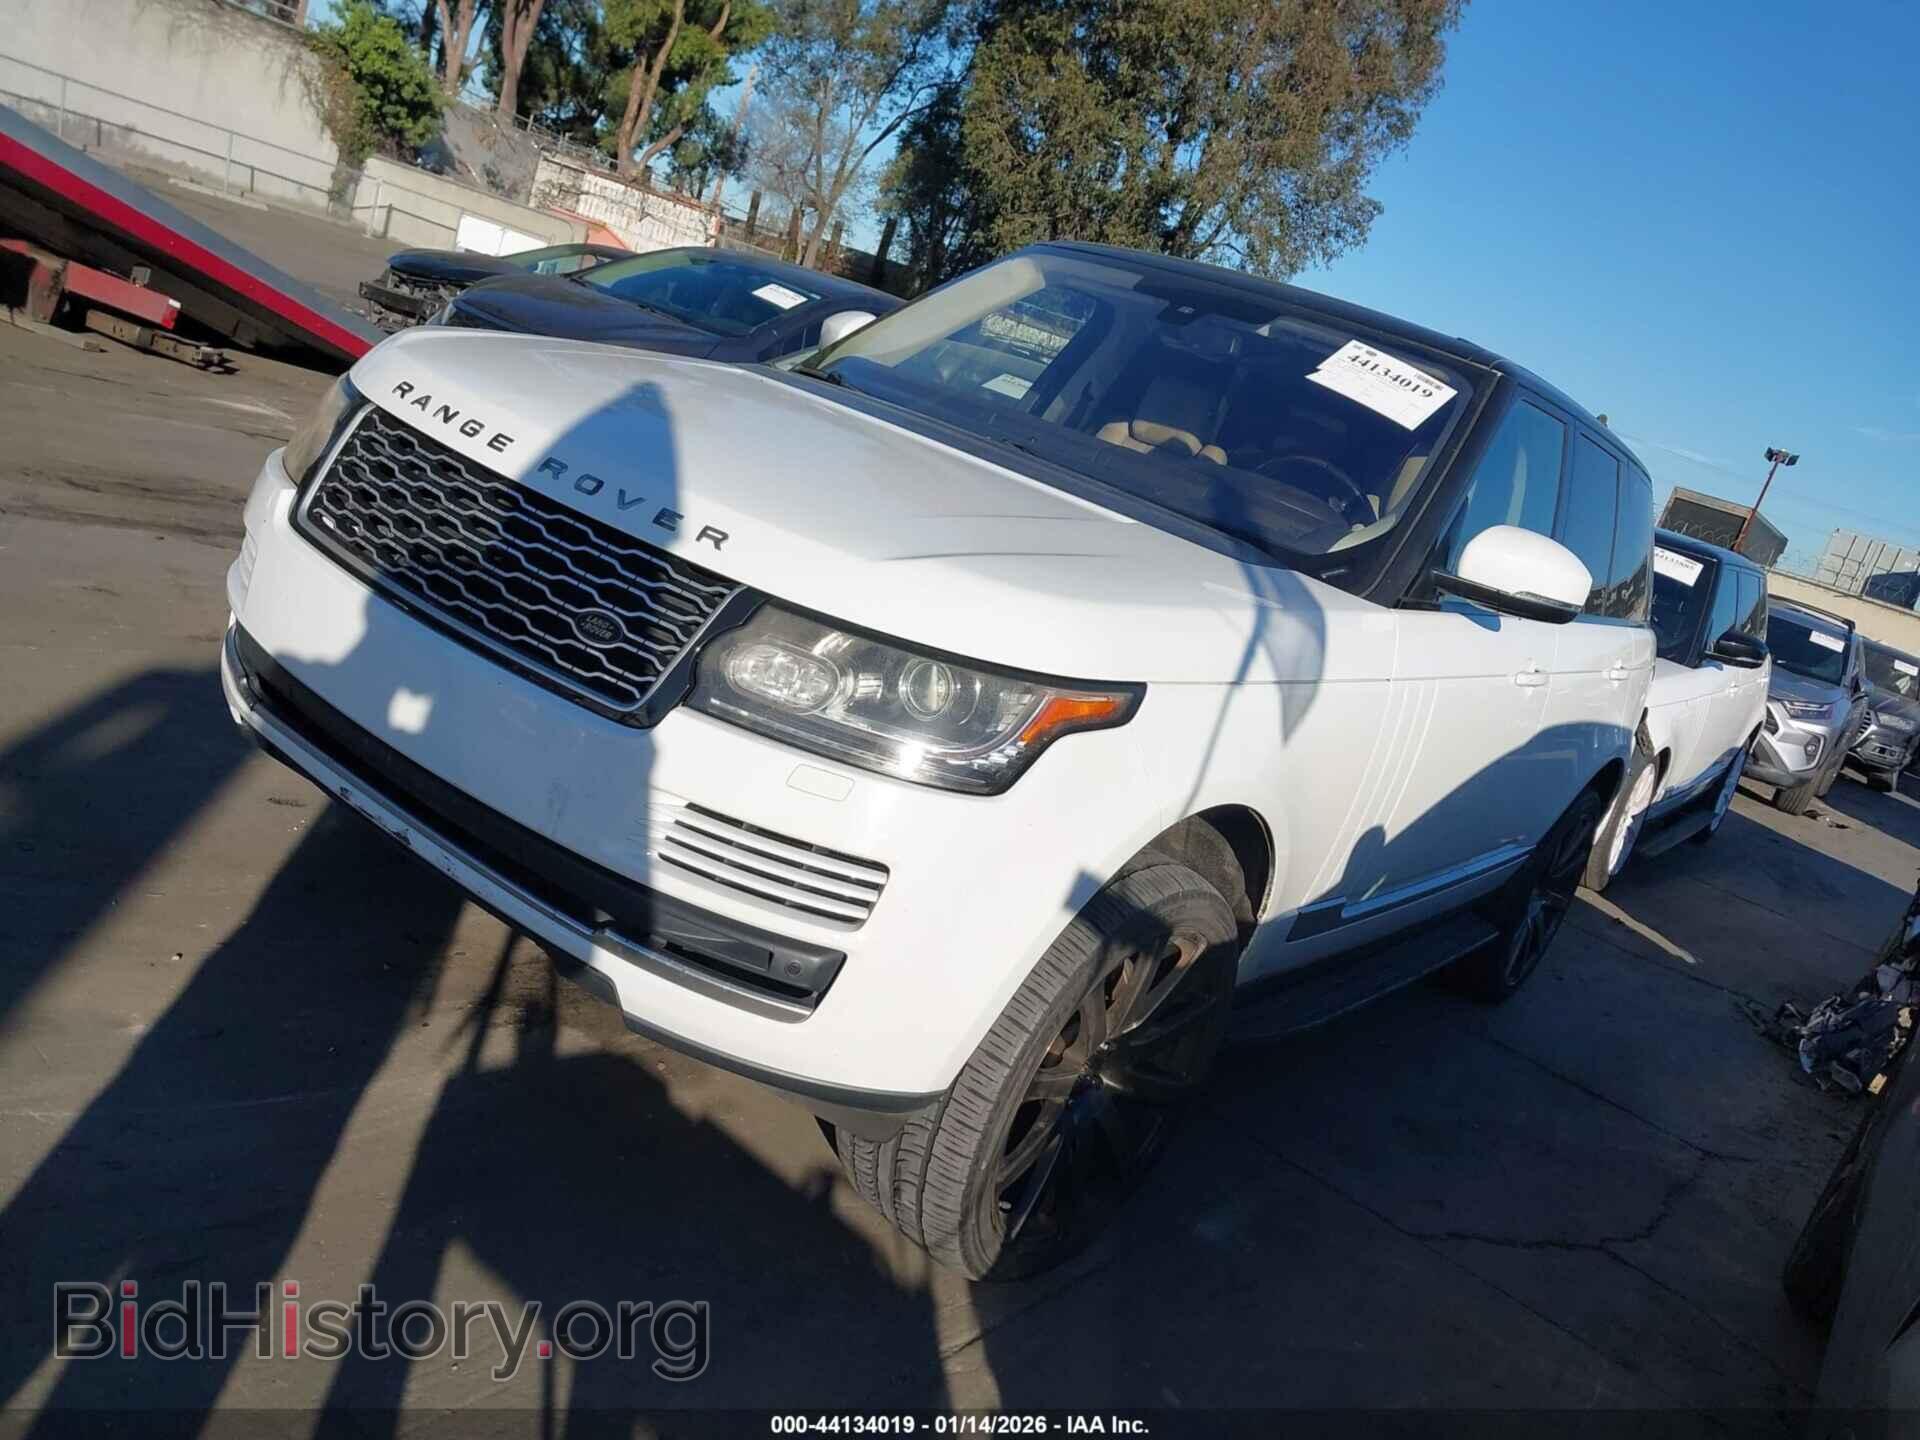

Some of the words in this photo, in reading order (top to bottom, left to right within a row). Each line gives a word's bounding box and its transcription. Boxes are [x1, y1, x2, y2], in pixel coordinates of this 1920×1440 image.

[1347, 355, 1433, 398] 44134019
[392, 380, 515, 453] RANGE
[537, 456, 730, 551] ROVER
